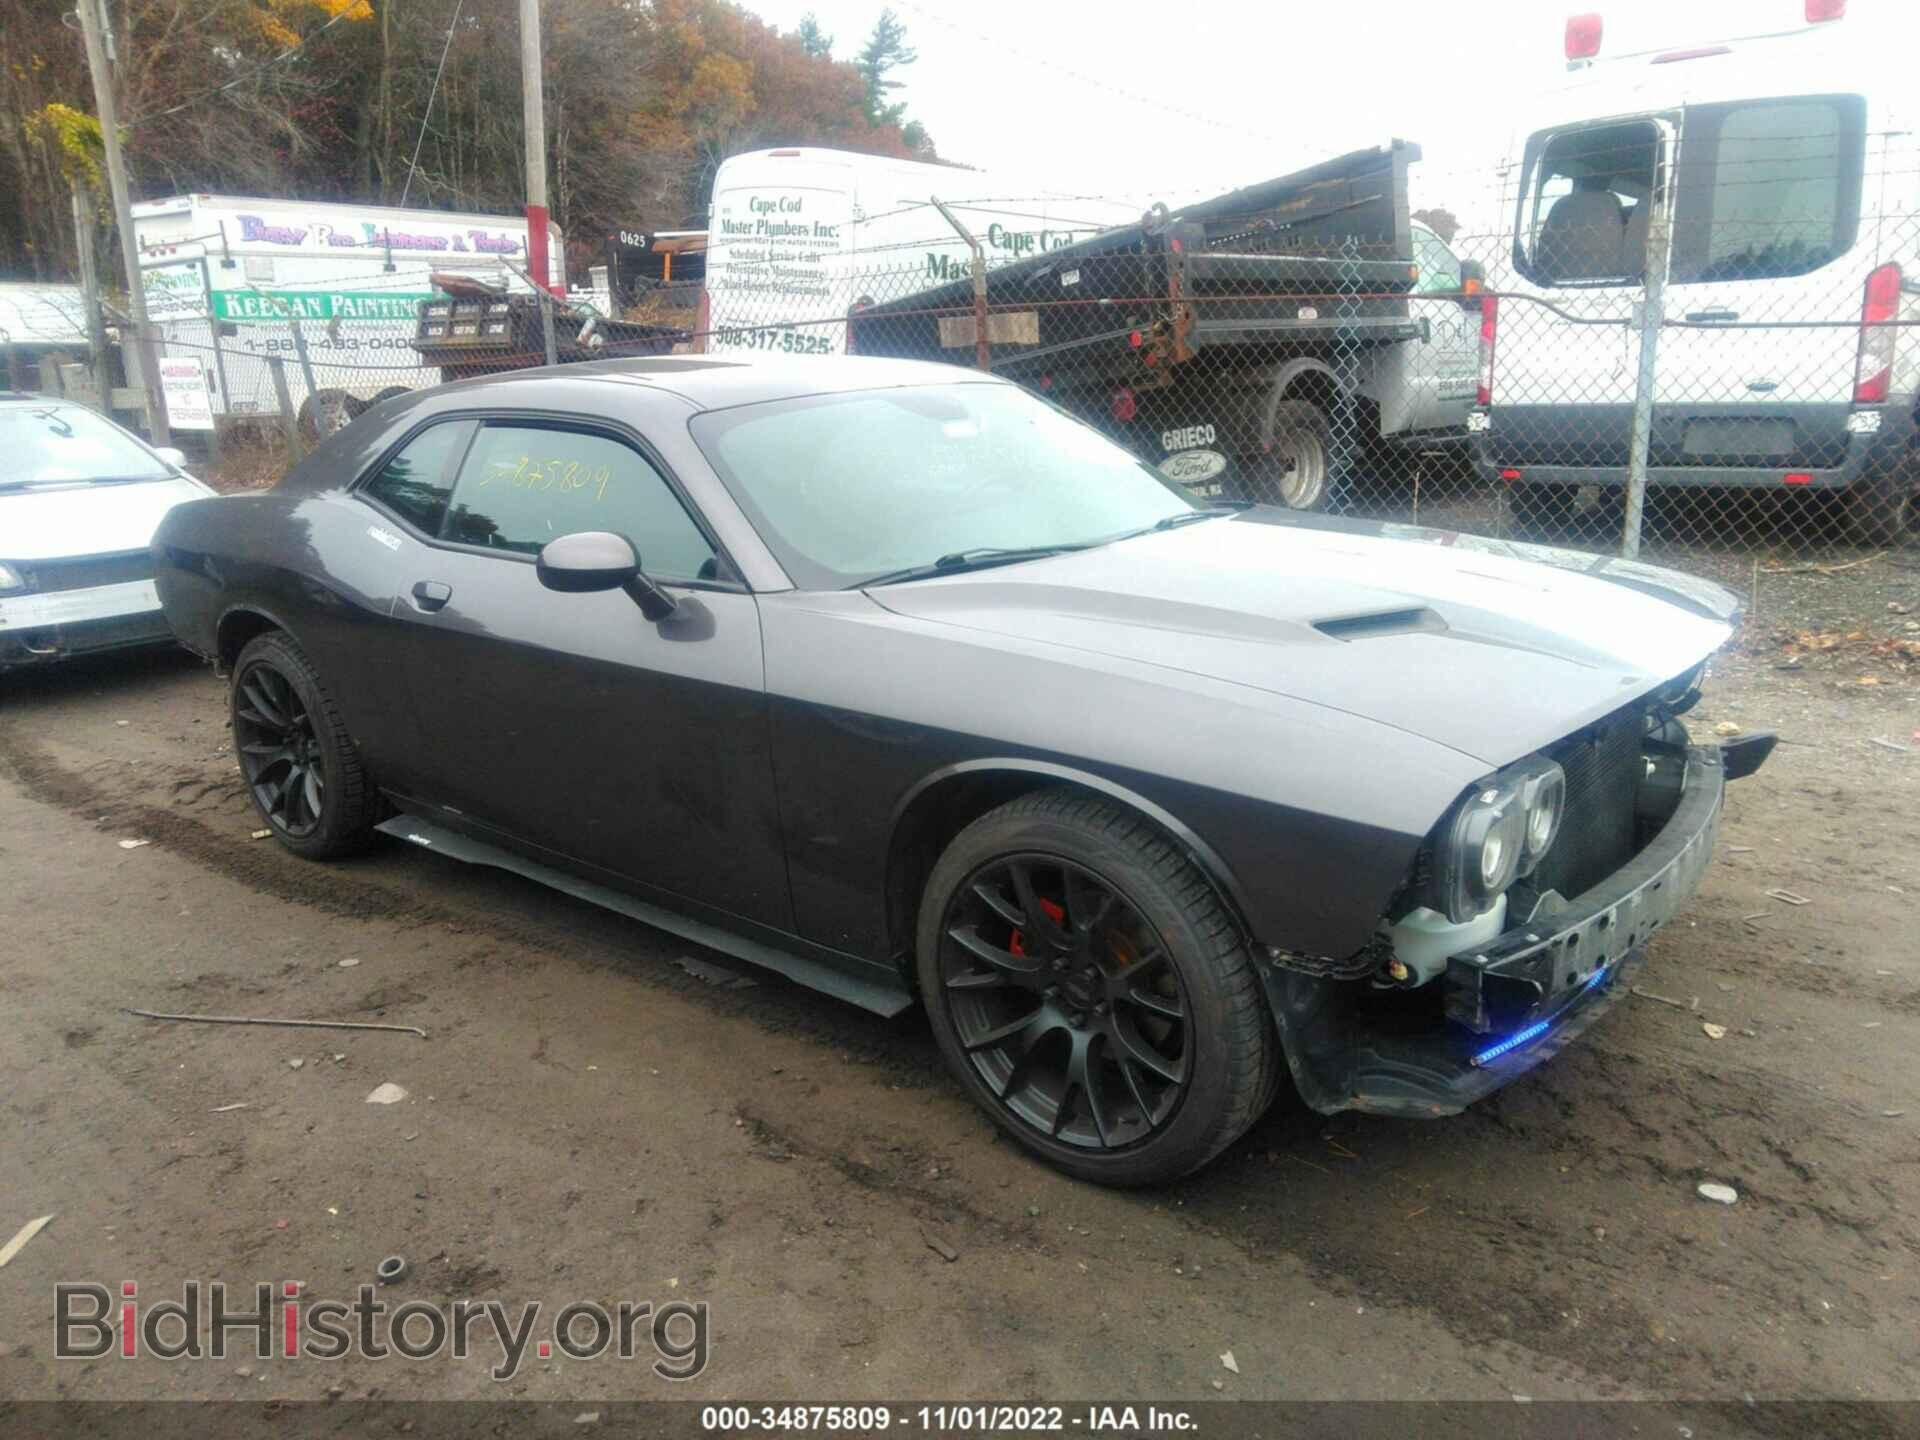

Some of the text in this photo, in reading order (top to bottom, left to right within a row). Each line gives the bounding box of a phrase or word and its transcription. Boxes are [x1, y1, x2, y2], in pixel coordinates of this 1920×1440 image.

[749, 195, 803, 216] Cape Cod
[721, 219, 754, 235] Master
[756, 219, 810, 237] Plumbers
[620, 230, 646, 248] 0625
[988, 222, 1034, 256] Cape
[1162, 424, 1216, 451] GRIECO
[1171, 457, 1213, 477] Ford
